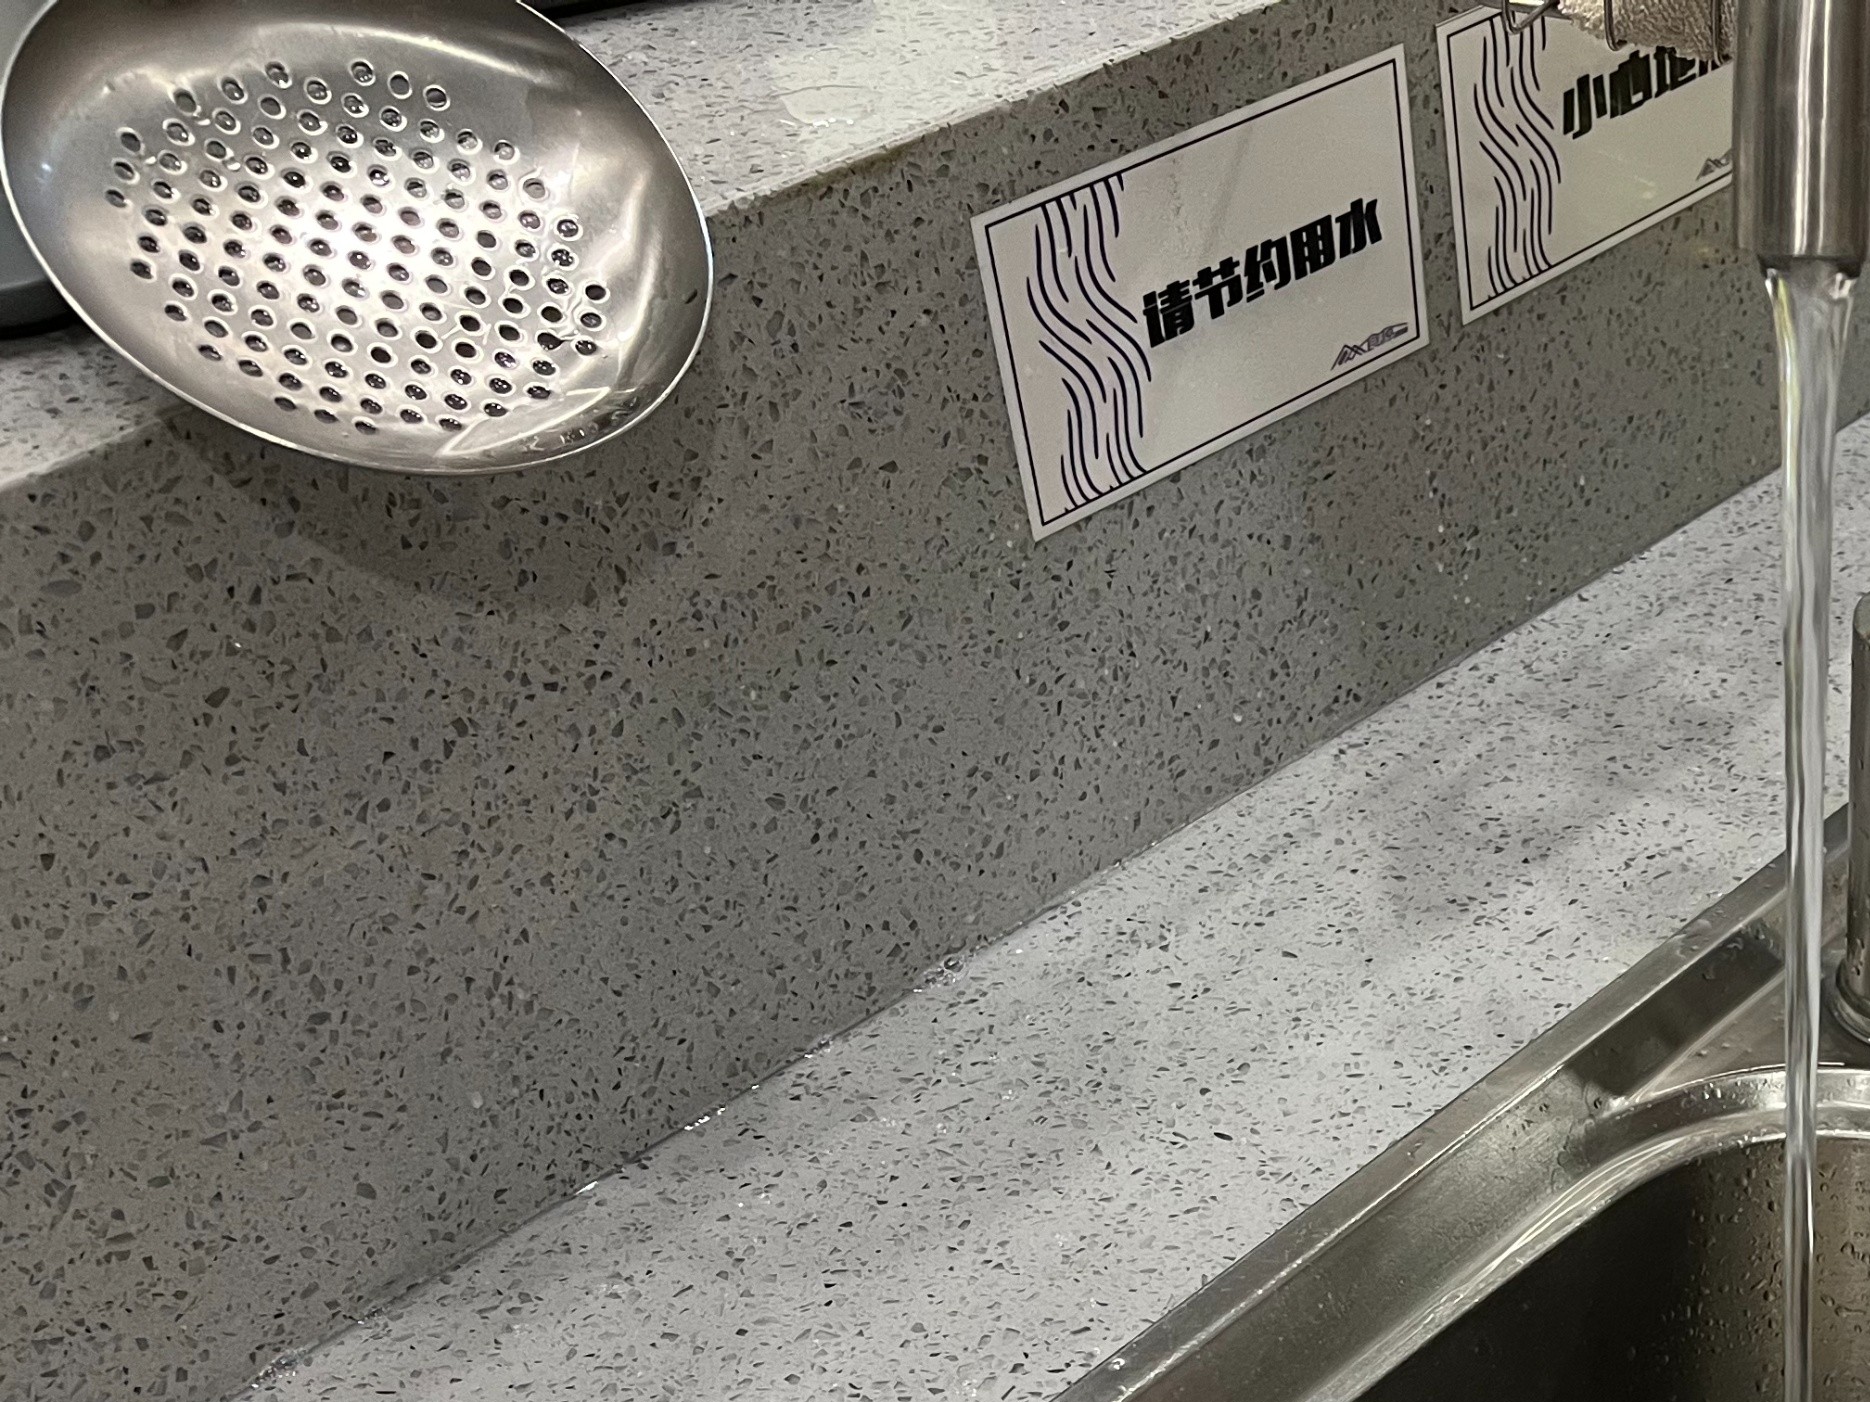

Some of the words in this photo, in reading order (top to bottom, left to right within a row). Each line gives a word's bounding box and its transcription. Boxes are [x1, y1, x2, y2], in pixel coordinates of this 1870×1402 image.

[1562, 46, 1722, 139] 小心地
[1142, 197, 1383, 349] 请节约用水
